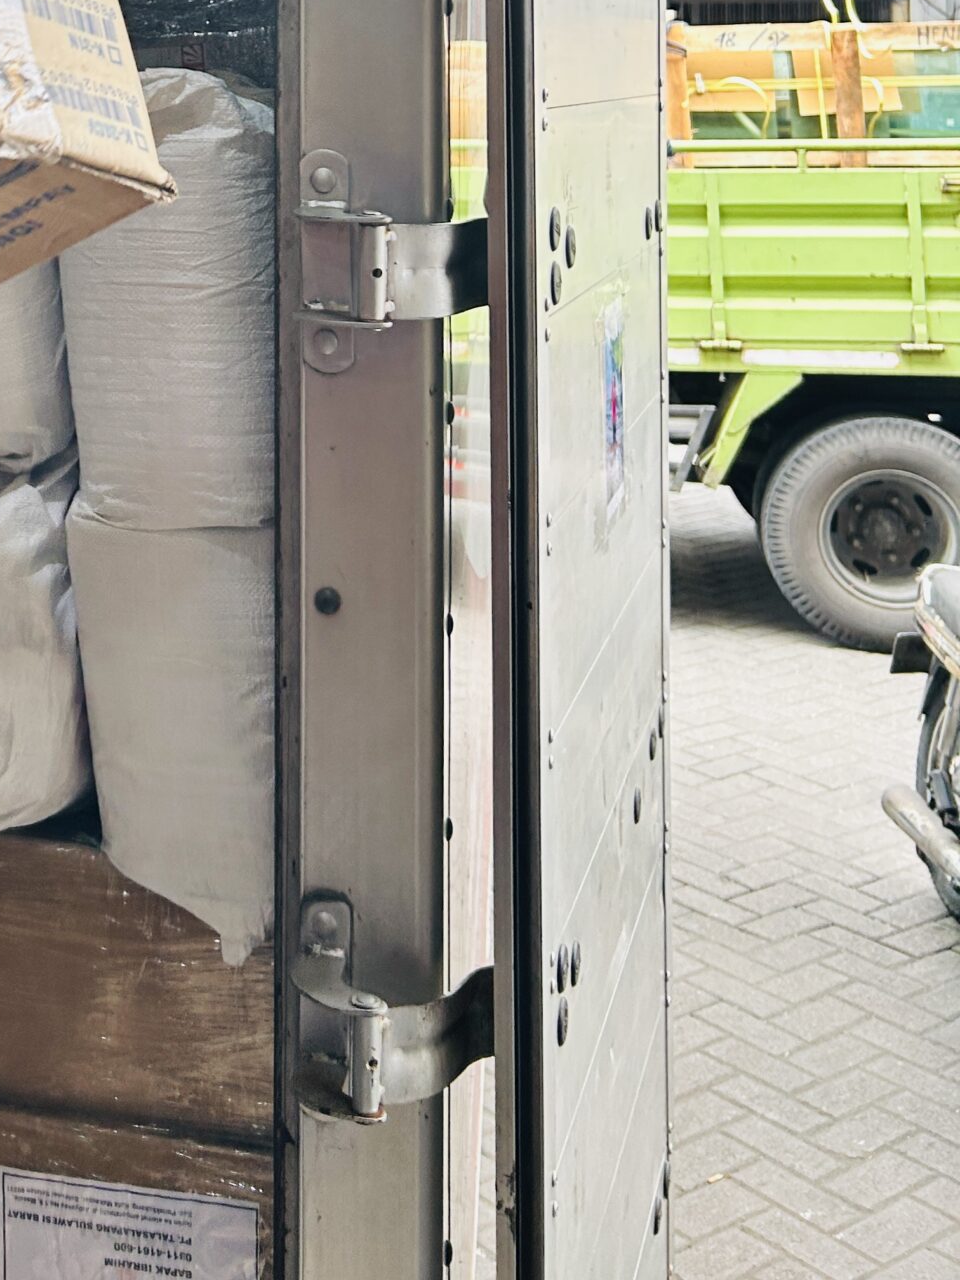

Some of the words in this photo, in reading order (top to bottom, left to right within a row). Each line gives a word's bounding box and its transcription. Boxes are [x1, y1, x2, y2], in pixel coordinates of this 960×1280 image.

[7, 1209, 40, 1221] BARAT
[41, 1213, 94, 1232] SULAWESI
[103, 1257, 154, 1274] IBRAHIM
[155, 1264, 193, 1280] BAPAK
